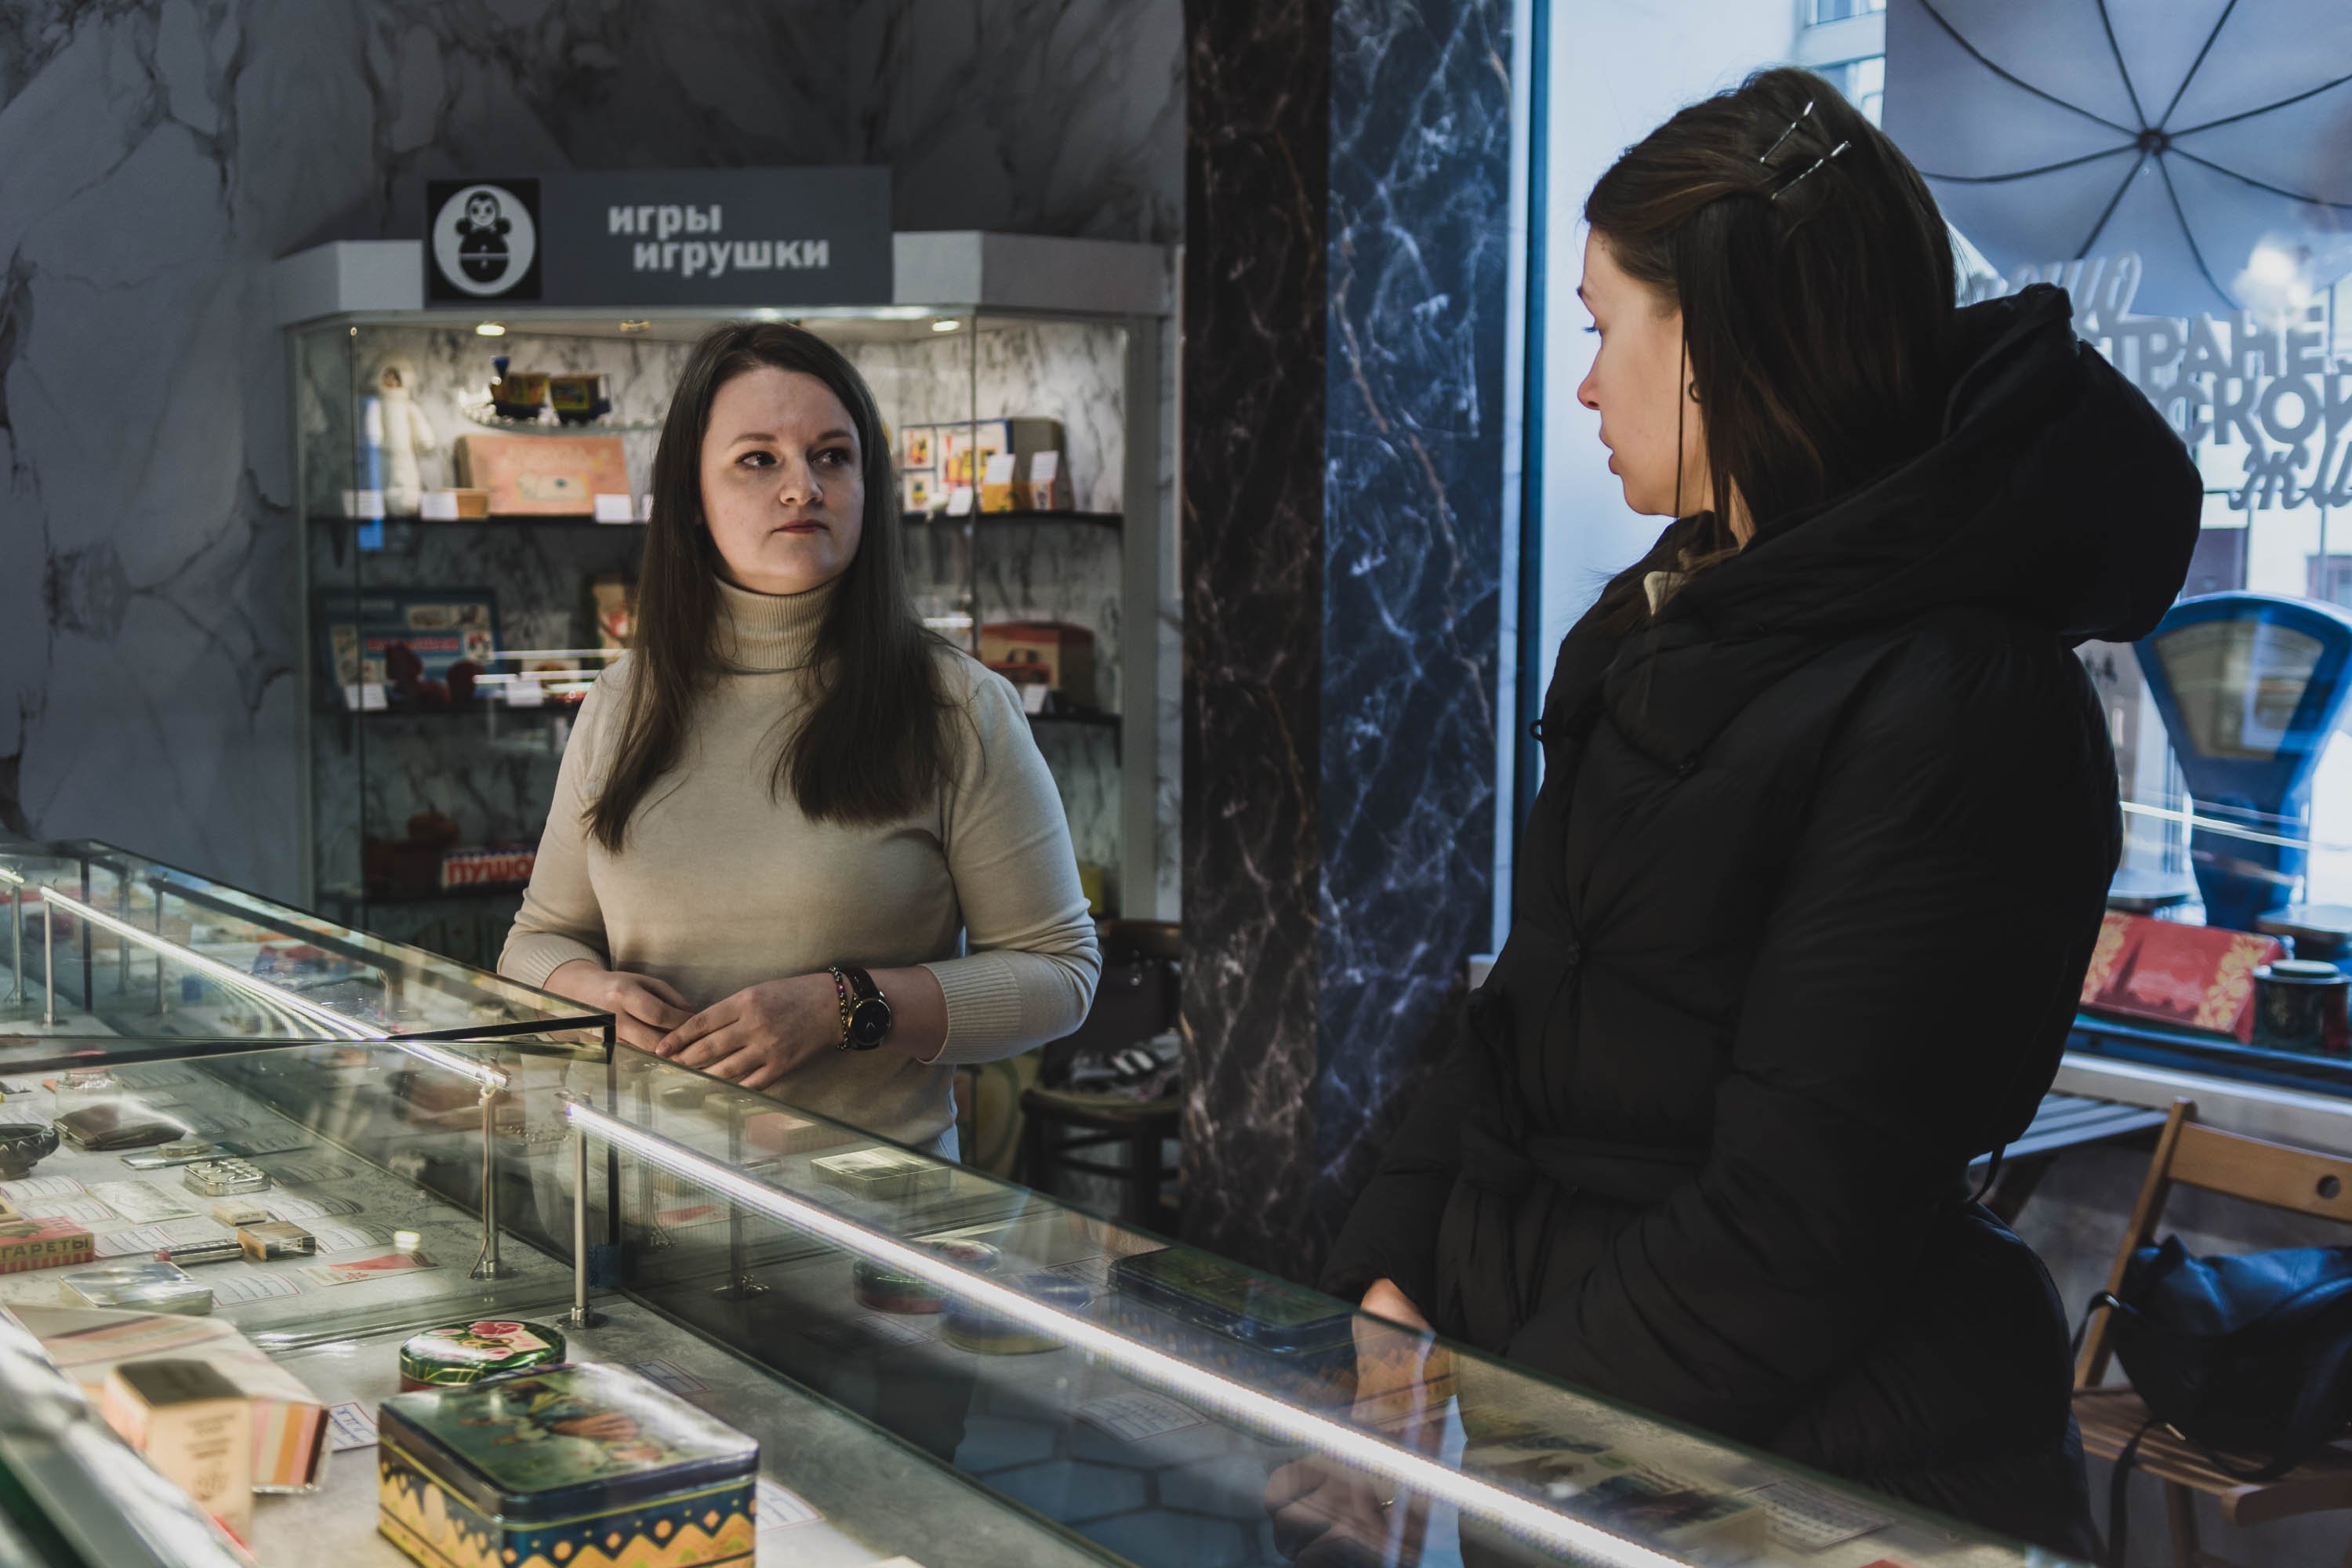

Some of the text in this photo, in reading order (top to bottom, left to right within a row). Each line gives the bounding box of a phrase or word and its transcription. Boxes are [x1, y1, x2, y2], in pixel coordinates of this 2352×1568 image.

[608, 205, 721, 239] игры
[633, 239, 829, 278] игрушки
[2092, 307, 2325, 394] ТРАНЕ
[448, 855, 533, 884] ПУШО
